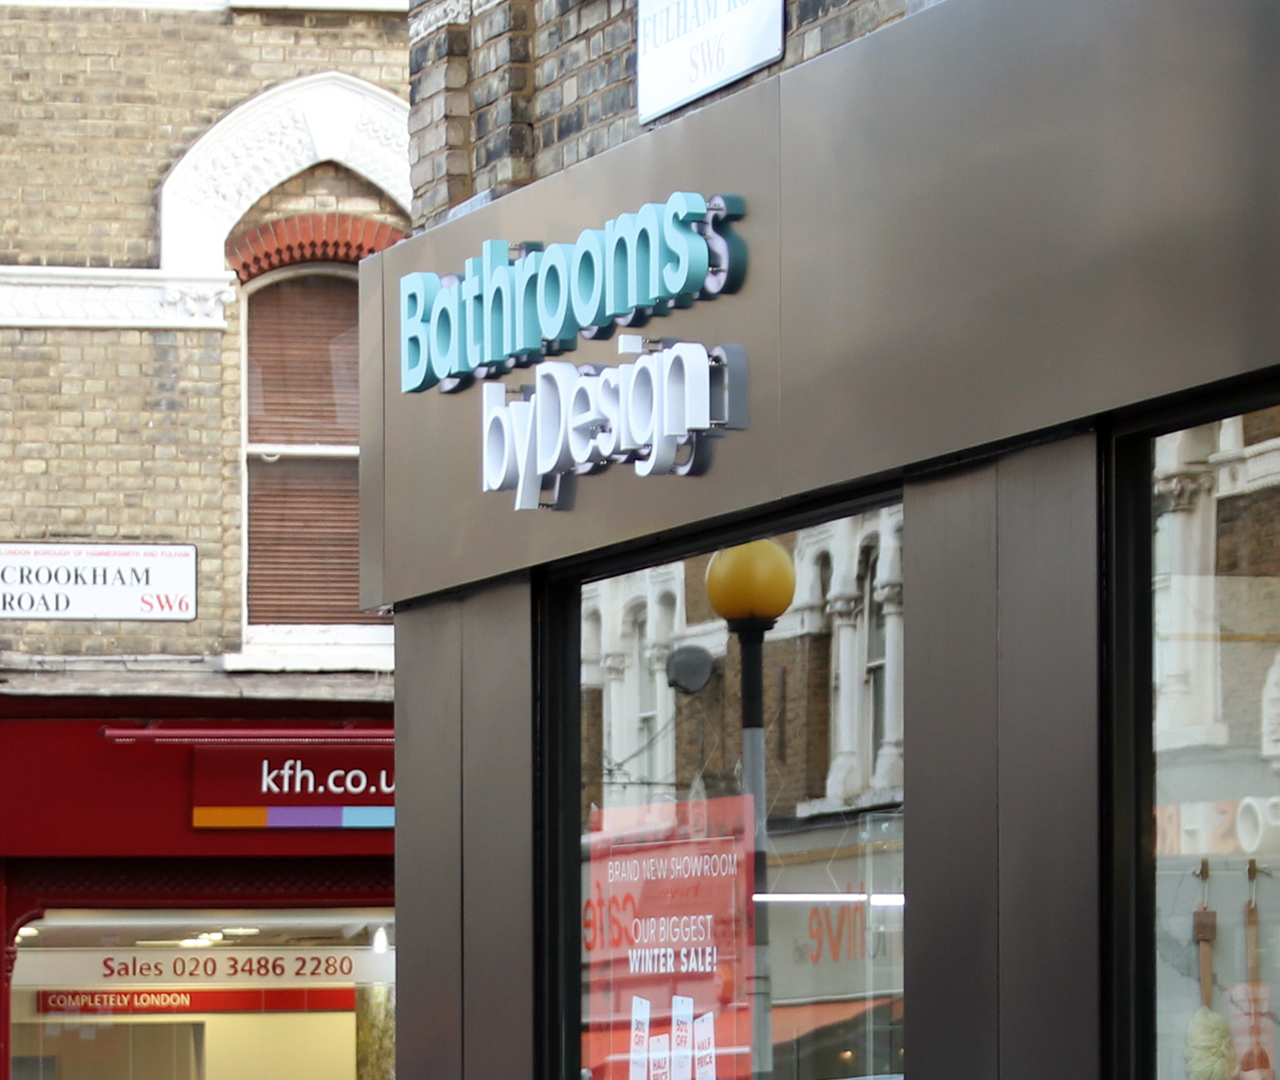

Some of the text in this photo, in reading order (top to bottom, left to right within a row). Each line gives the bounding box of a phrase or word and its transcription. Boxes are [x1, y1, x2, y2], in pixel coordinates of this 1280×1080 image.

[689, 31, 725, 84] SW6
[400, 191, 709, 393] Bathrooms
[482, 334, 711, 511] byDesign
[0, 565, 151, 586] CROOKHAM
[1, 592, 190, 613] ROAD SW6
[261, 759, 395, 794] kfh.co.u
[608, 853, 738, 883] BRAND NEW SHOWROOM
[631, 914, 713, 944] OUR BIGGEST
[102, 955, 354, 979] Sales 020 3486 2280
[628, 946, 718, 974] WINTER SALE!
[48, 992, 191, 1007] COMPLETELY LONDON
